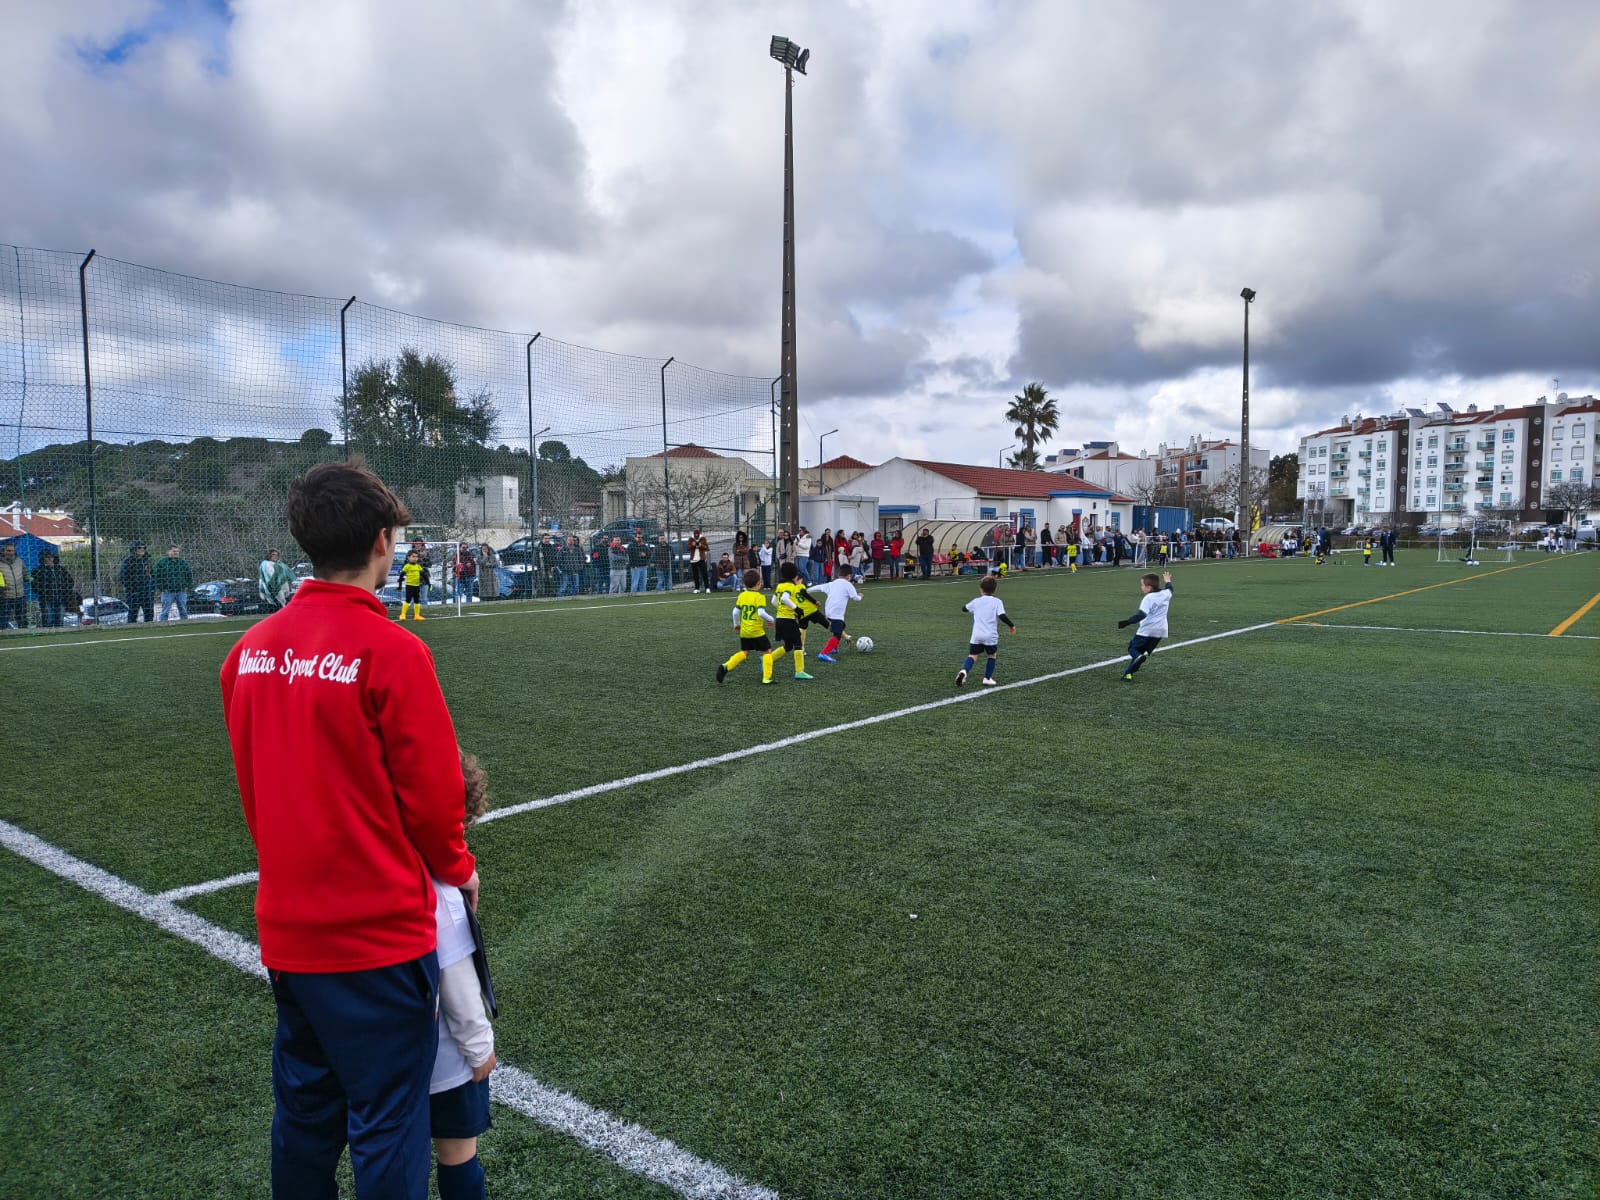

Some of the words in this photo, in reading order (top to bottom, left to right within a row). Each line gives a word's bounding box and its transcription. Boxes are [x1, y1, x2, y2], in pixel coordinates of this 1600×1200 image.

[742, 605, 756, 620] 32
[238, 648, 275, 676] União
[280, 648, 319, 684] Sport
[318, 652, 361, 684] Club
